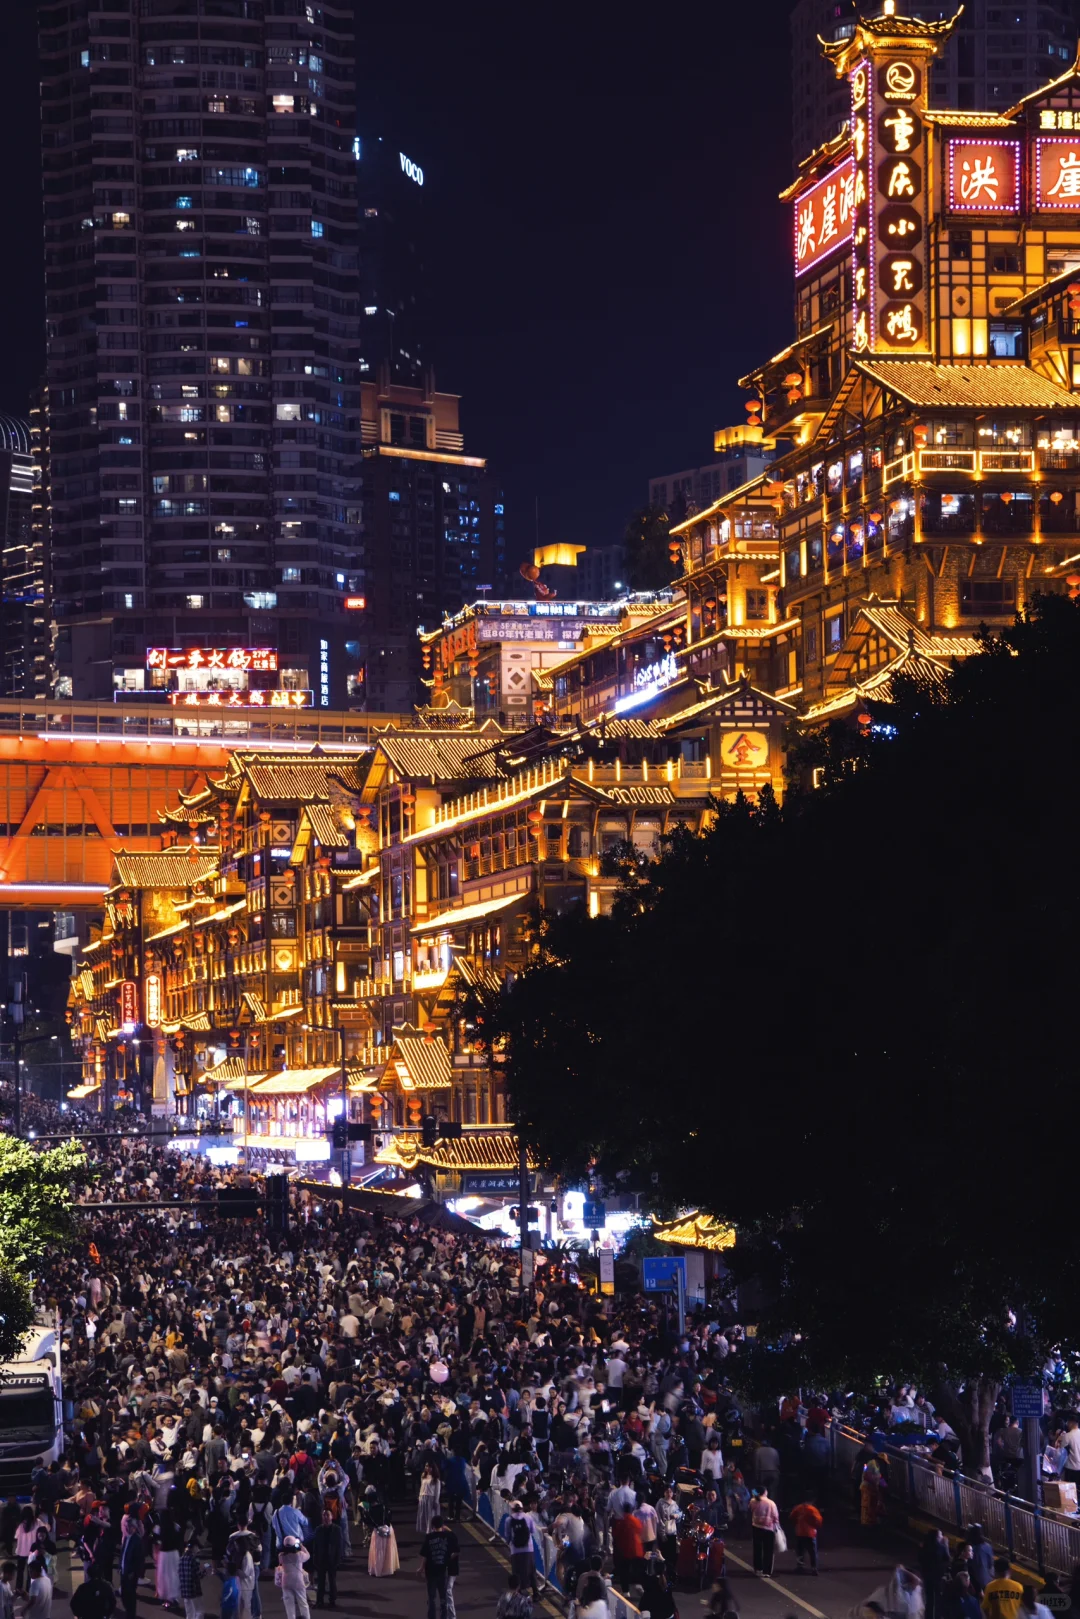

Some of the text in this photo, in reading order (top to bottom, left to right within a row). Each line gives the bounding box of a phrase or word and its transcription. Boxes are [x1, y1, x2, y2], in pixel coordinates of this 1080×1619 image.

[886, 108, 918, 342] 重庆小天鹅
[148, 649, 251, 669] 刘一手火锅
